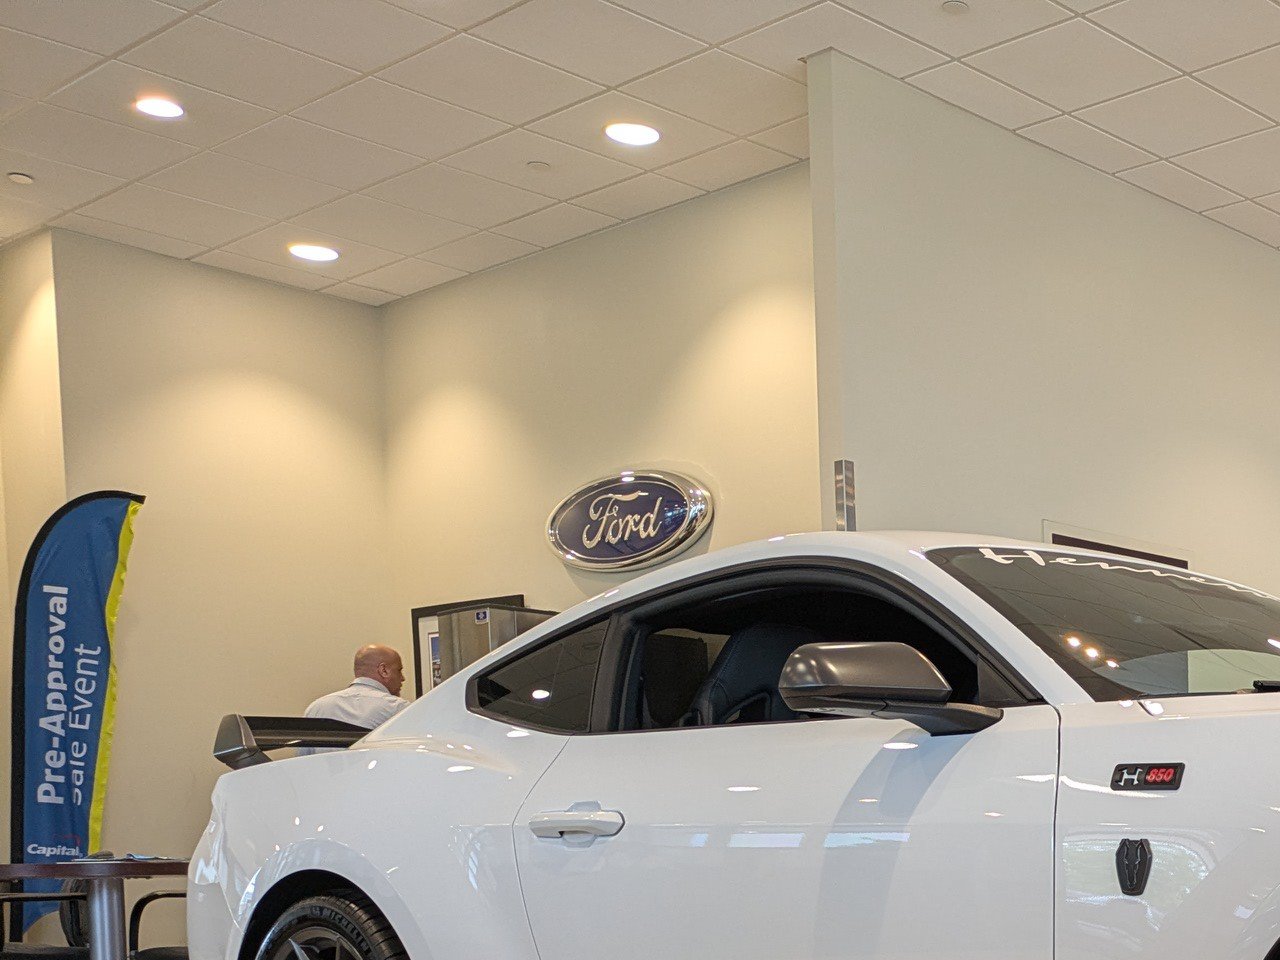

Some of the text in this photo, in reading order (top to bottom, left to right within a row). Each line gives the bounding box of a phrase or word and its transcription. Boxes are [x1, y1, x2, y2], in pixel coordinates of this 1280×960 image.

[582, 490, 663, 549] Ford
[37, 585, 69, 804] Pre-Approval
[68, 643, 102, 728] Event
[1145, 768, 1175, 783] 850
[27, 843, 80, 858] Capital
